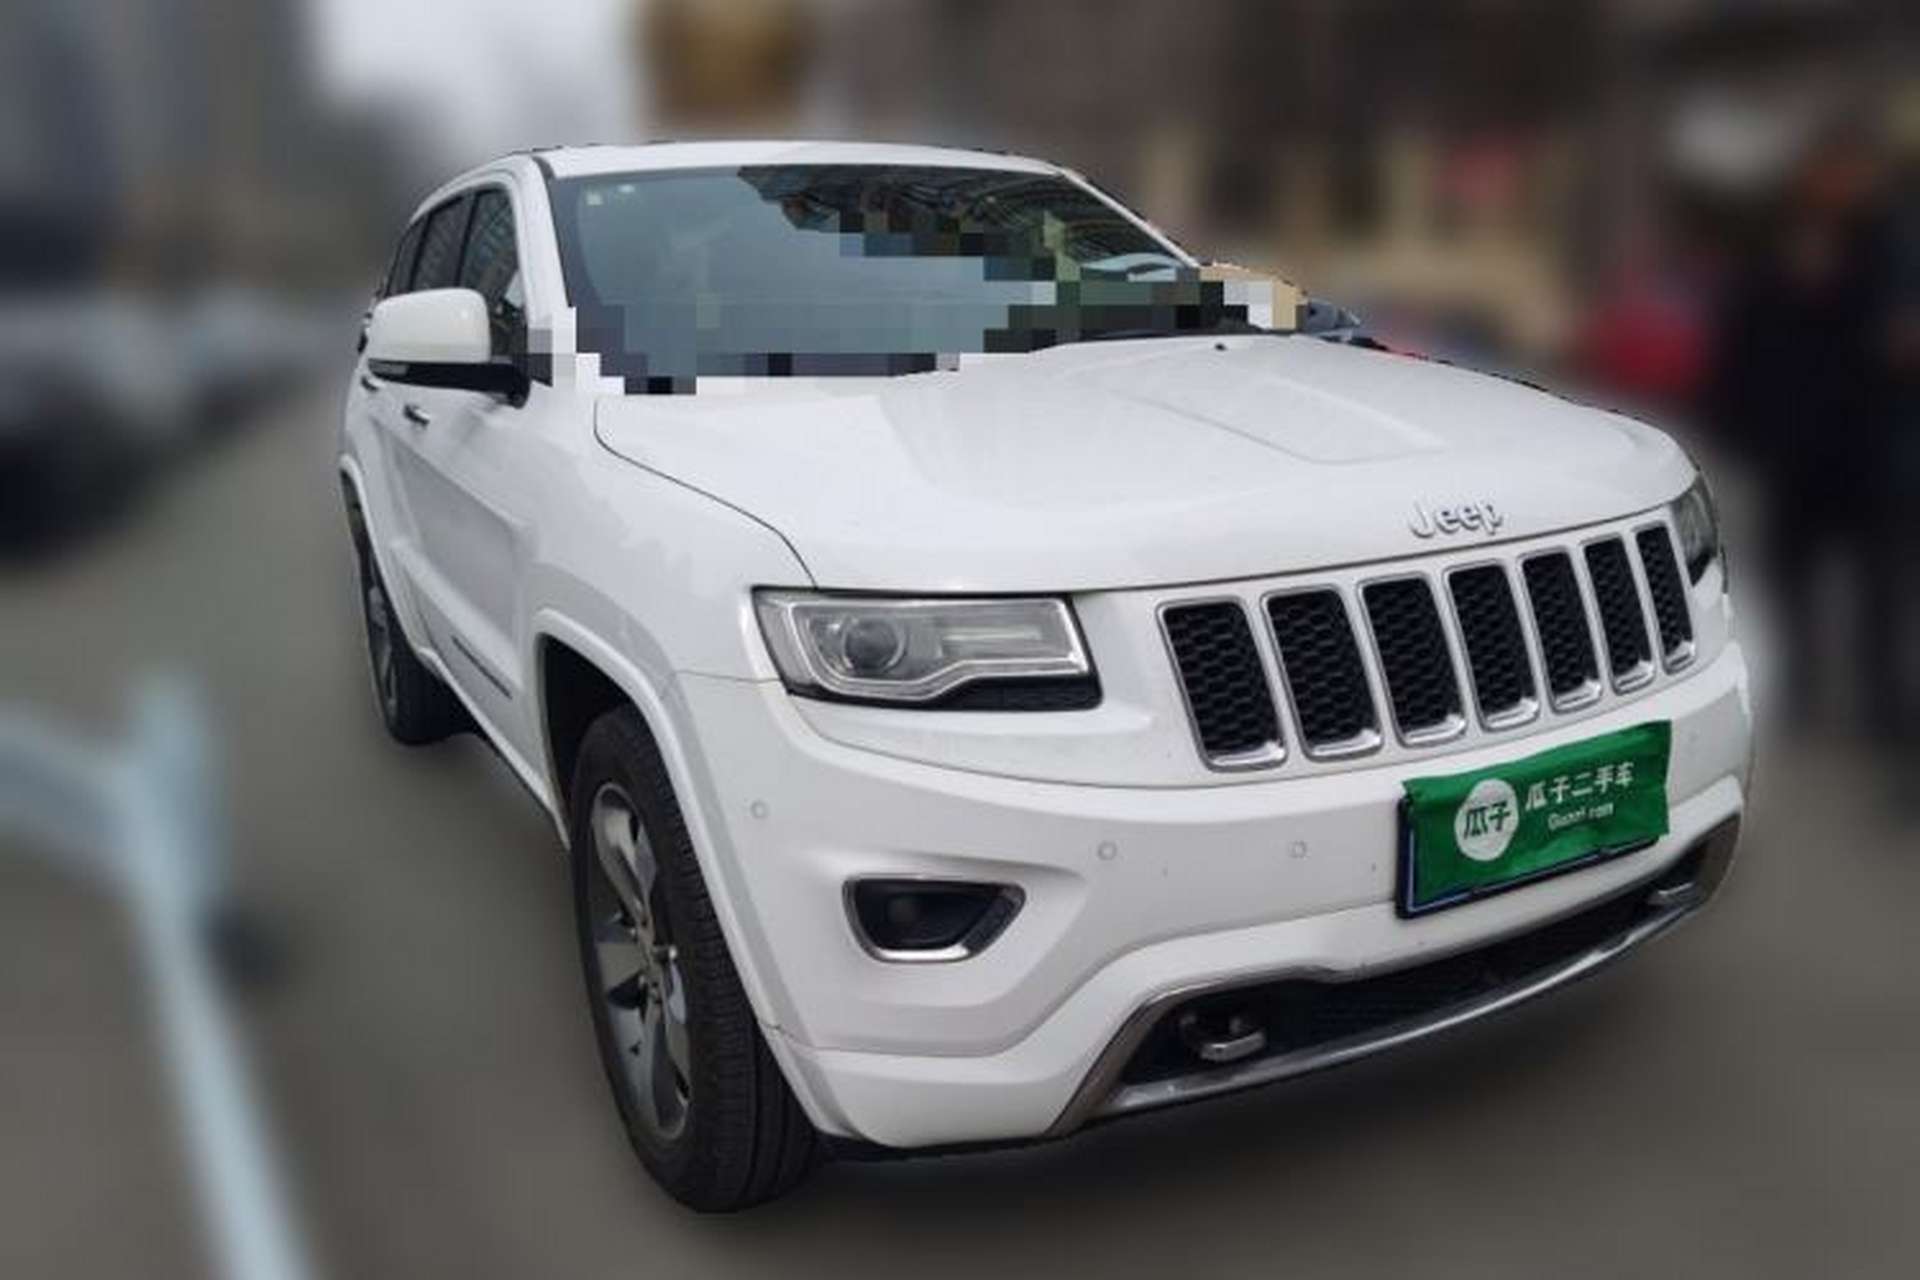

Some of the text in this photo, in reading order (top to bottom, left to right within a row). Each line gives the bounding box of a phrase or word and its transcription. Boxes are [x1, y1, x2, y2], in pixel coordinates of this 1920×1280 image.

[1409, 497, 1504, 539] Jeep
[1525, 761, 1634, 812] 瓜子二手车
[1463, 802, 1511, 839] 瓜子
